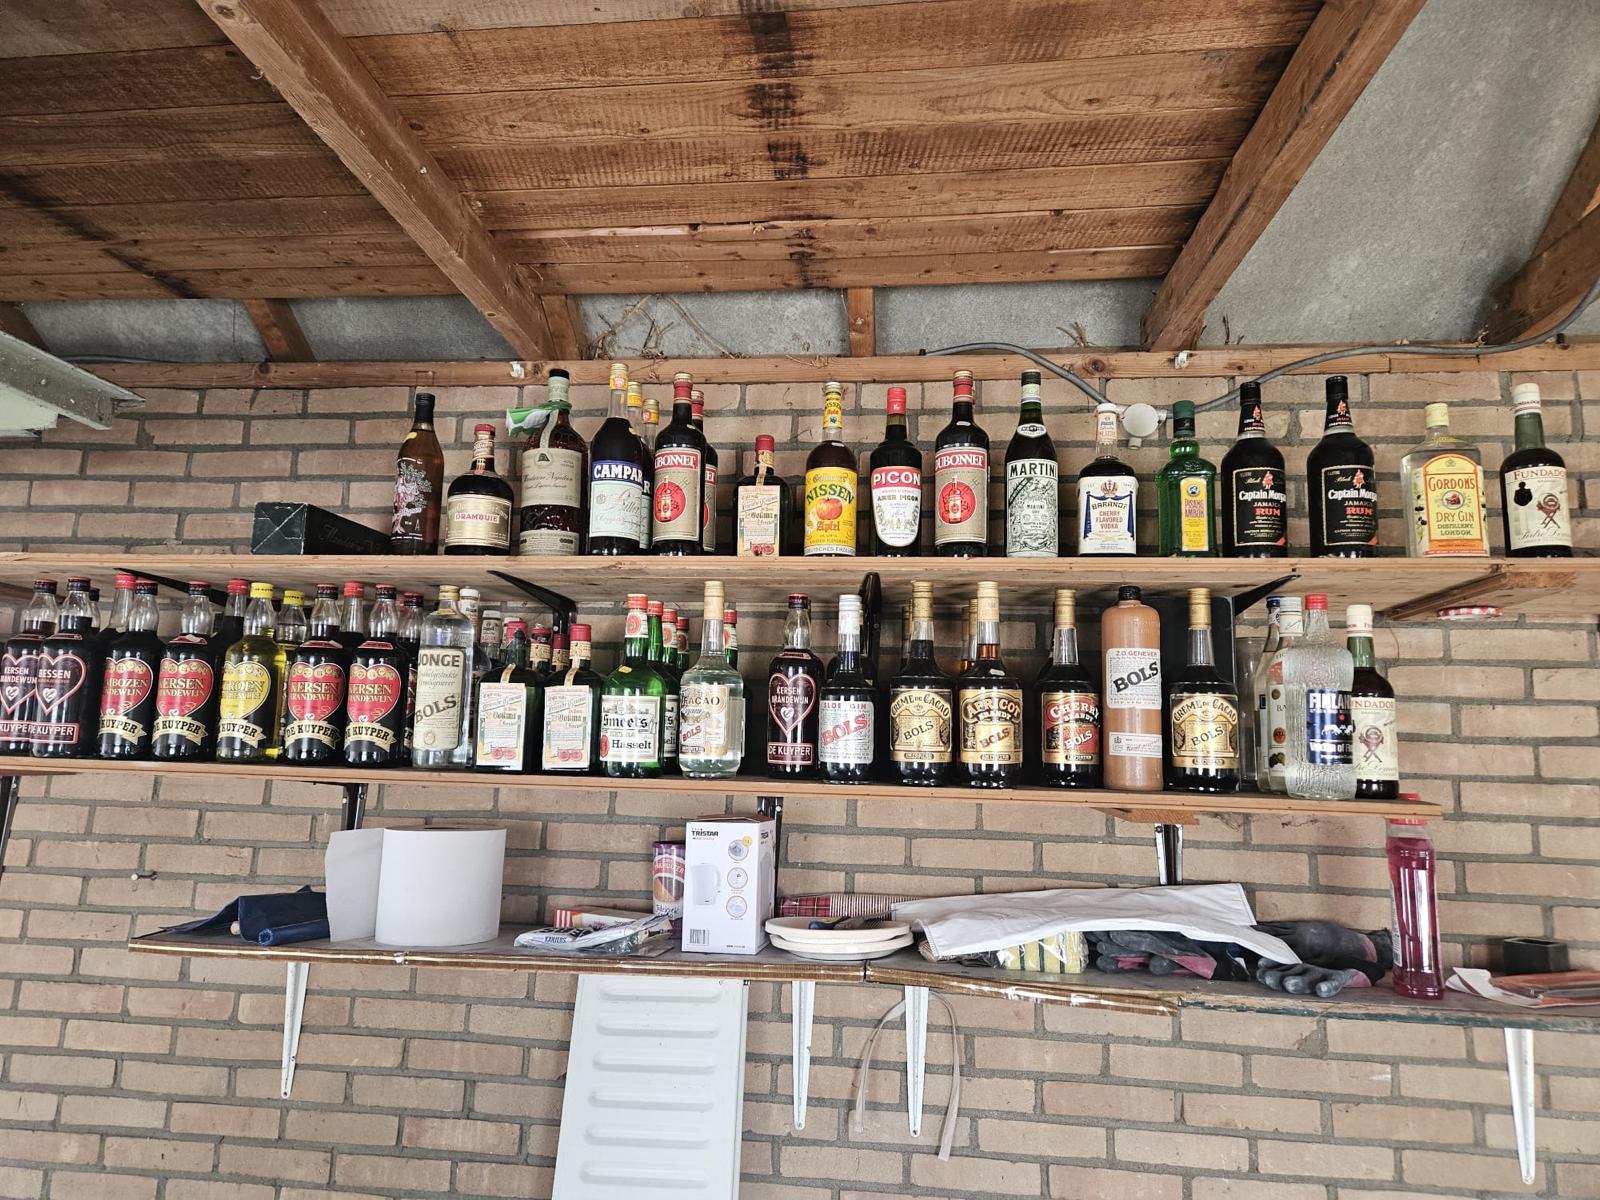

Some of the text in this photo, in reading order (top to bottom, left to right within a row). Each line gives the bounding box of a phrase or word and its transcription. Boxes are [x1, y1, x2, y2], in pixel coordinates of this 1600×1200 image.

[873, 471, 920, 486] PICON
[1428, 476, 1476, 492] GORDON'S
[807, 483, 854, 504] NISSEN
[1239, 489, 1268, 501] Captain
[1328, 488, 1359, 500] Captain
[455, 512, 498, 522] DRAMBUIE
[1254, 508, 1281, 516] RUM
[1435, 510, 1475, 522] DRY GIN
[38, 669, 71, 679] BESSEN
[1113, 661, 1159, 693] BOLS
[415, 694, 457, 724] BOLS
[923, 693, 950, 717] CACAO
[966, 698, 1022, 720] APRICOT
[1050, 702, 1100, 720] CHERRY
[1212, 698, 1237, 723] CACAO
[162, 720, 202, 735] KUYPER
[297, 724, 337, 738] KUYPER
[352, 725, 390, 741] KUYPER
[682, 725, 702, 742] BOLS
[821, 713, 868, 746] BOLS
[903, 720, 934, 741] BOLS
[1191, 726, 1224, 746] BOLS
[979, 728, 1009, 748] BOLS
[1064, 730, 1092, 749] BOLS
[778, 745, 811, 756] KUYPER
